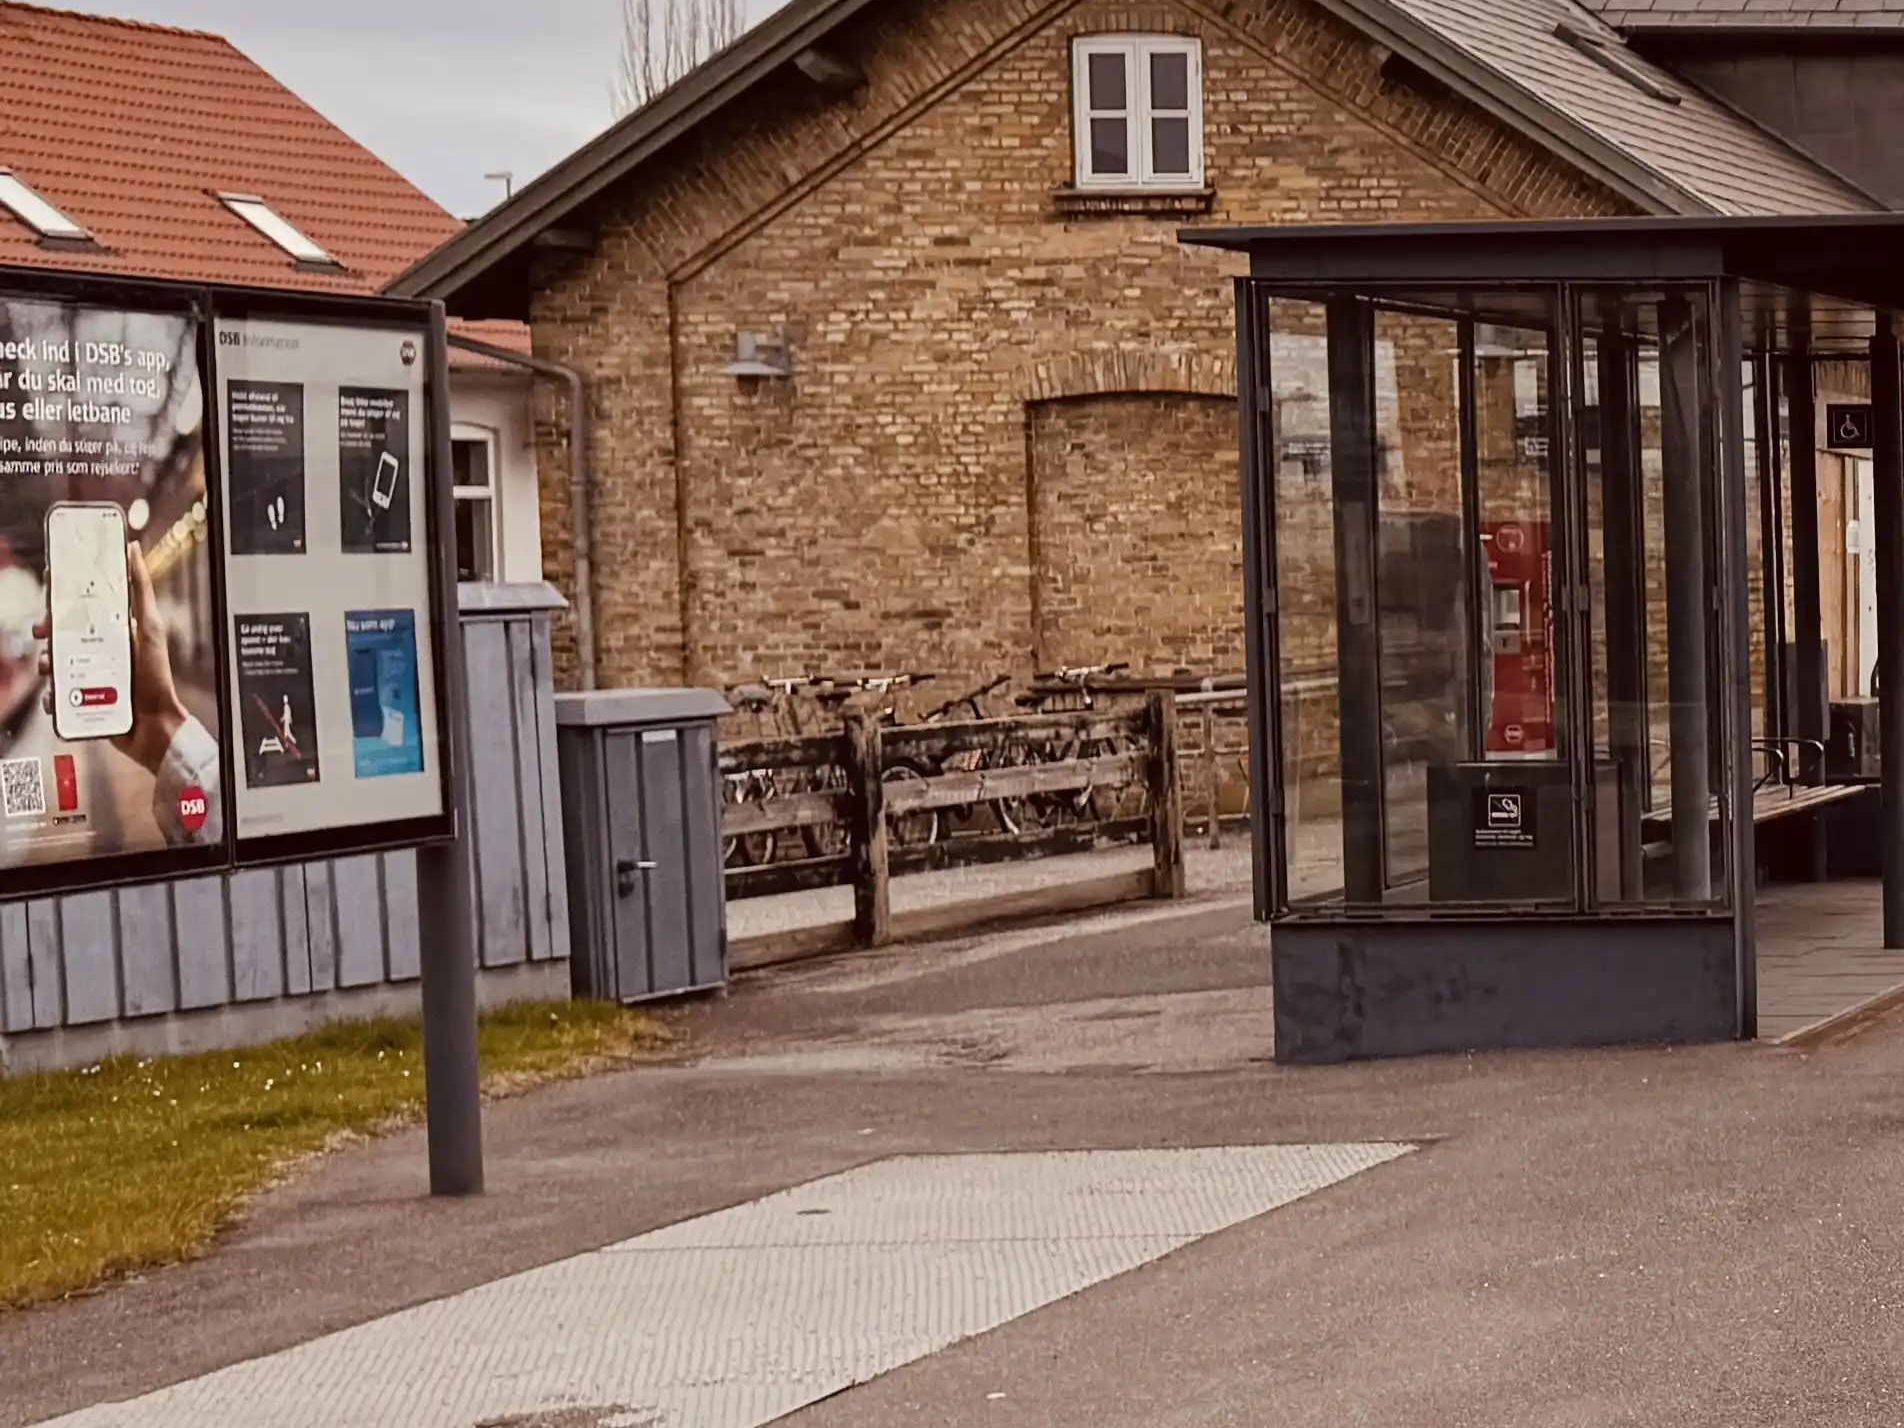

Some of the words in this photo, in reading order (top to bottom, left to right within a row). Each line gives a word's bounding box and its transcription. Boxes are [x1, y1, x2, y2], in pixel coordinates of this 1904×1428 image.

[42, 339, 70, 363] ind
[86, 341, 133, 367] DSB's
[137, 349, 171, 373] app,
[18, 368, 42, 392] du
[47, 369, 81, 393] skal
[87, 372, 125, 394] med
[130, 375, 161, 400] tog,
[22, 397, 63, 422] eller
[67, 398, 132, 424] letbane
[25, 436, 57, 453] inden
[59, 437, 73, 453] du
[44, 459, 64, 477] pris
[66, 462, 89, 476] som
[180, 797, 206, 816] DSB
